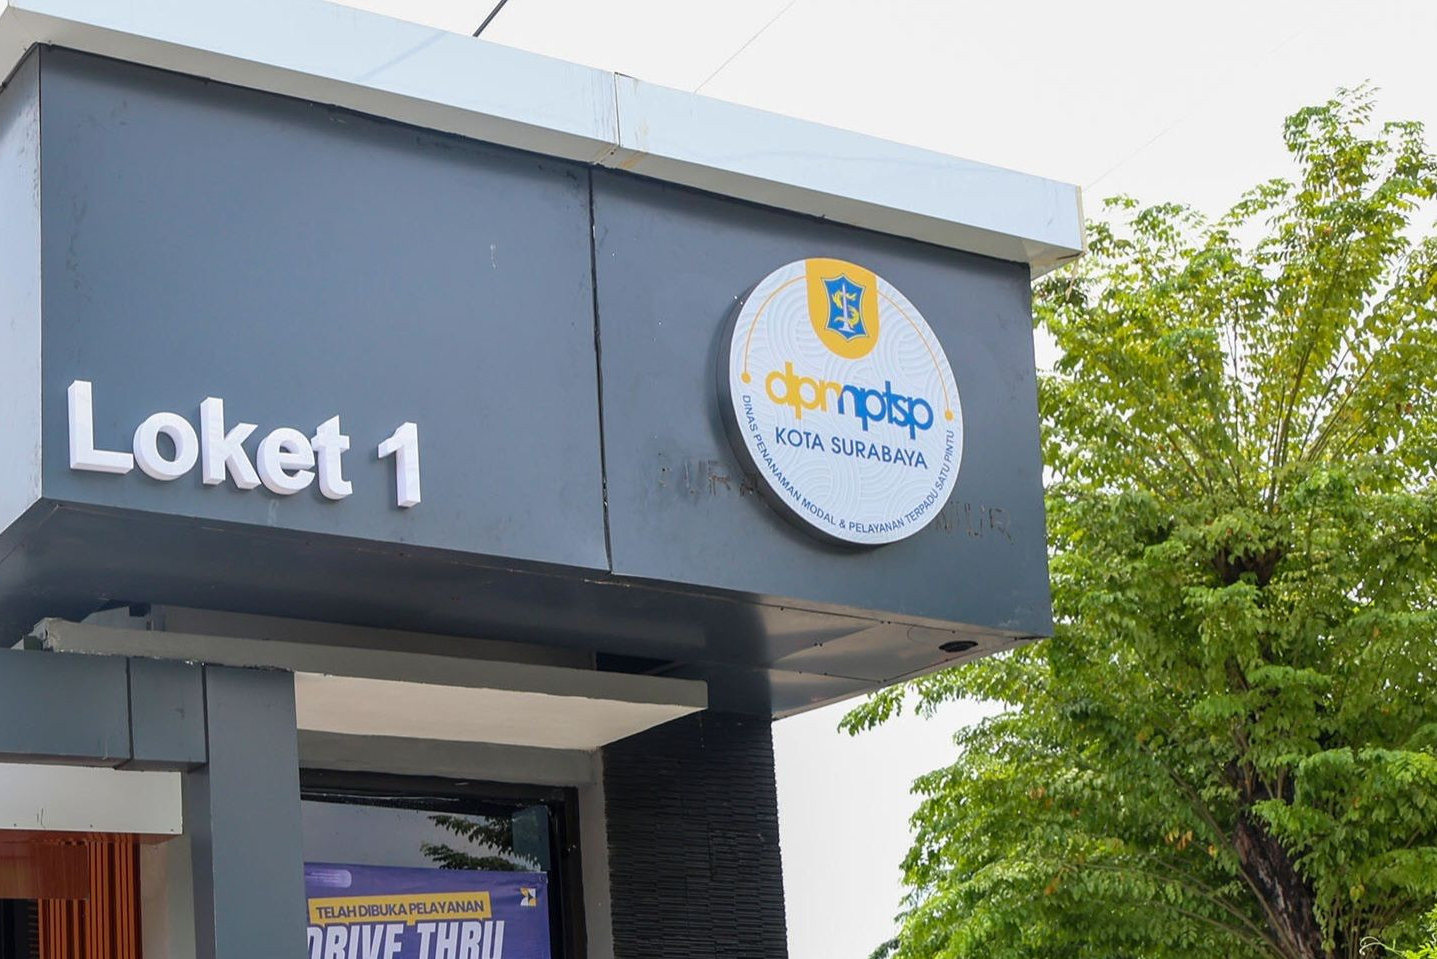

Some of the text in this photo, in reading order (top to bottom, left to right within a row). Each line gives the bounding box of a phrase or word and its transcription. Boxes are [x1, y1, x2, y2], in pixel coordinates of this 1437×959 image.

[68, 380, 421, 508] Loket 1
[742, 394, 758, 431] DINAS
[753, 434, 802, 502] PENANAMAN
[801, 498, 836, 526] MODAL
[840, 518, 847, 529] &
[848, 519, 904, 534] PELAYANAN
[905, 491, 939, 524] TERPADU
[935, 464, 951, 492] SATU
[944, 430, 955, 464] PINTU
[775, 427, 928, 469] KOTA SURABAYA
[315, 900, 484, 919] TELAH DIBUKA PELAYANAN
